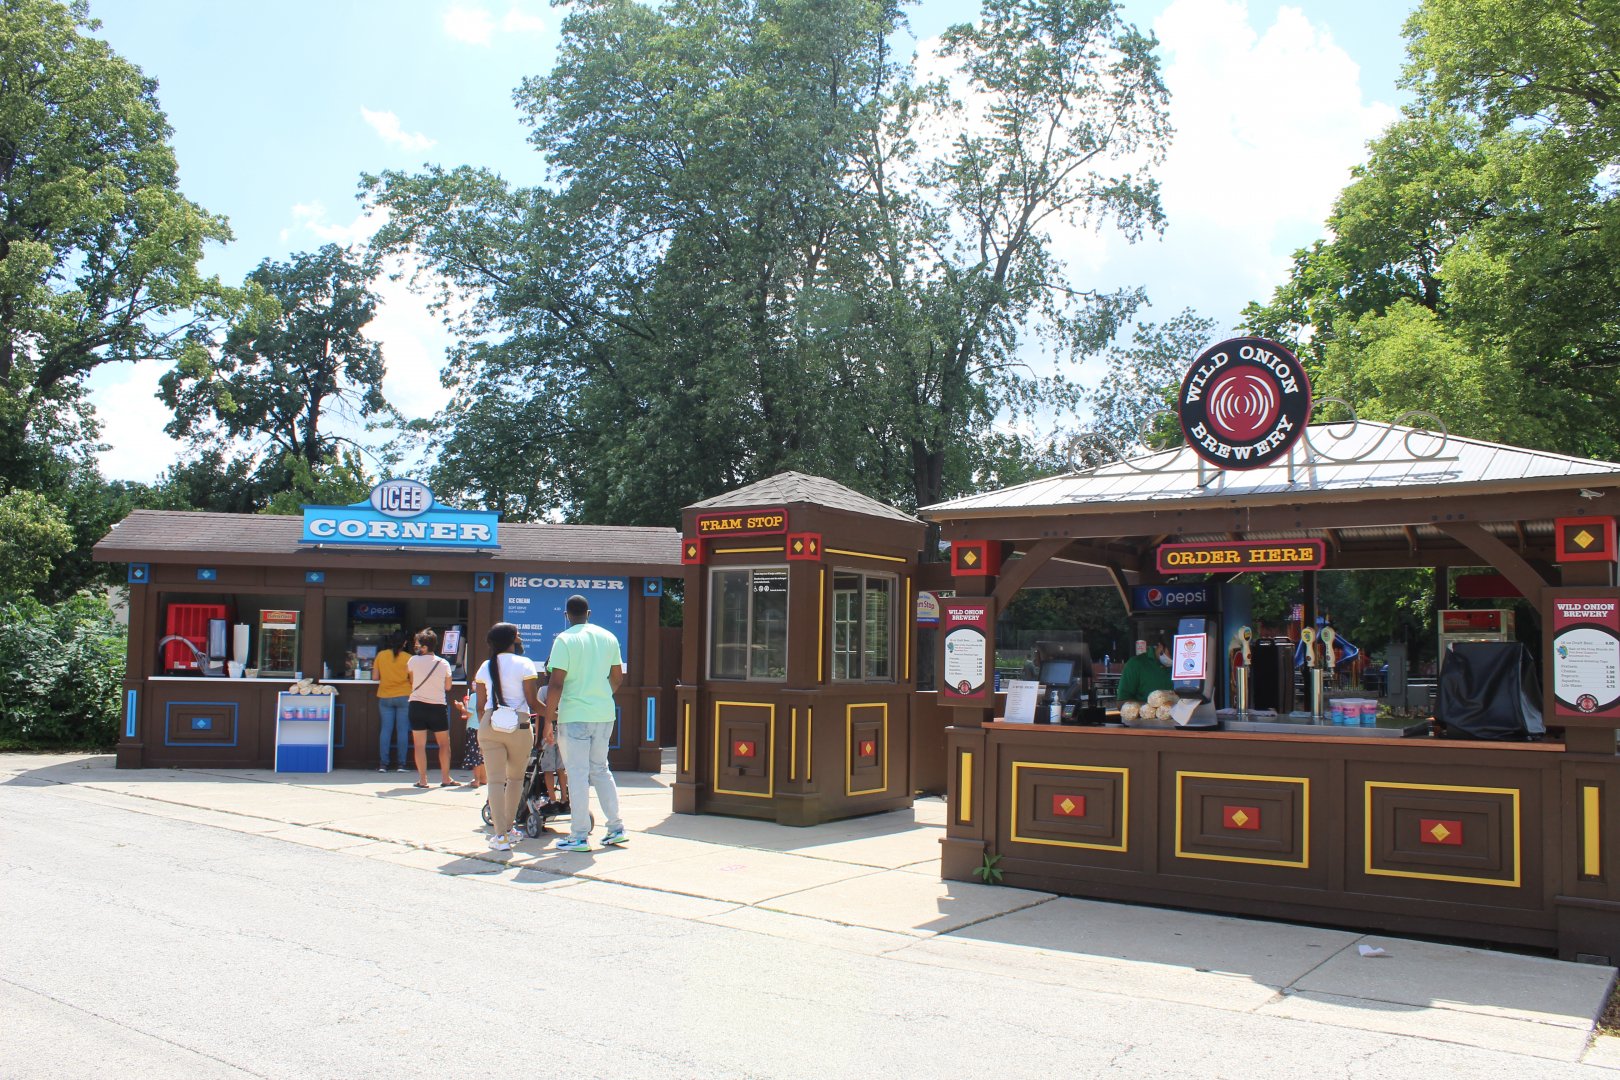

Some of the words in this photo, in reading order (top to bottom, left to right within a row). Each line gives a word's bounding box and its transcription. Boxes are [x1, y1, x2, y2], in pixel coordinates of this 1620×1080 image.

[1186, 352, 1229, 404] WILD
[1239, 346, 1299, 395] ONION
[1190, 414, 1294, 460] BREWERY
[381, 486, 422, 511] ICEE
[309, 519, 491, 541] CORNER
[700, 518, 743, 531] TRAM
[747, 516, 783, 529] STOP
[1167, 550, 1241, 565] ORDER
[1248, 547, 1313, 563] HERE
[509, 577, 527, 588] ICEE
[528, 578, 624, 590] CORNER
[1166, 589, 1206, 606] pepsi
[370, 606, 396, 616] pepsi
